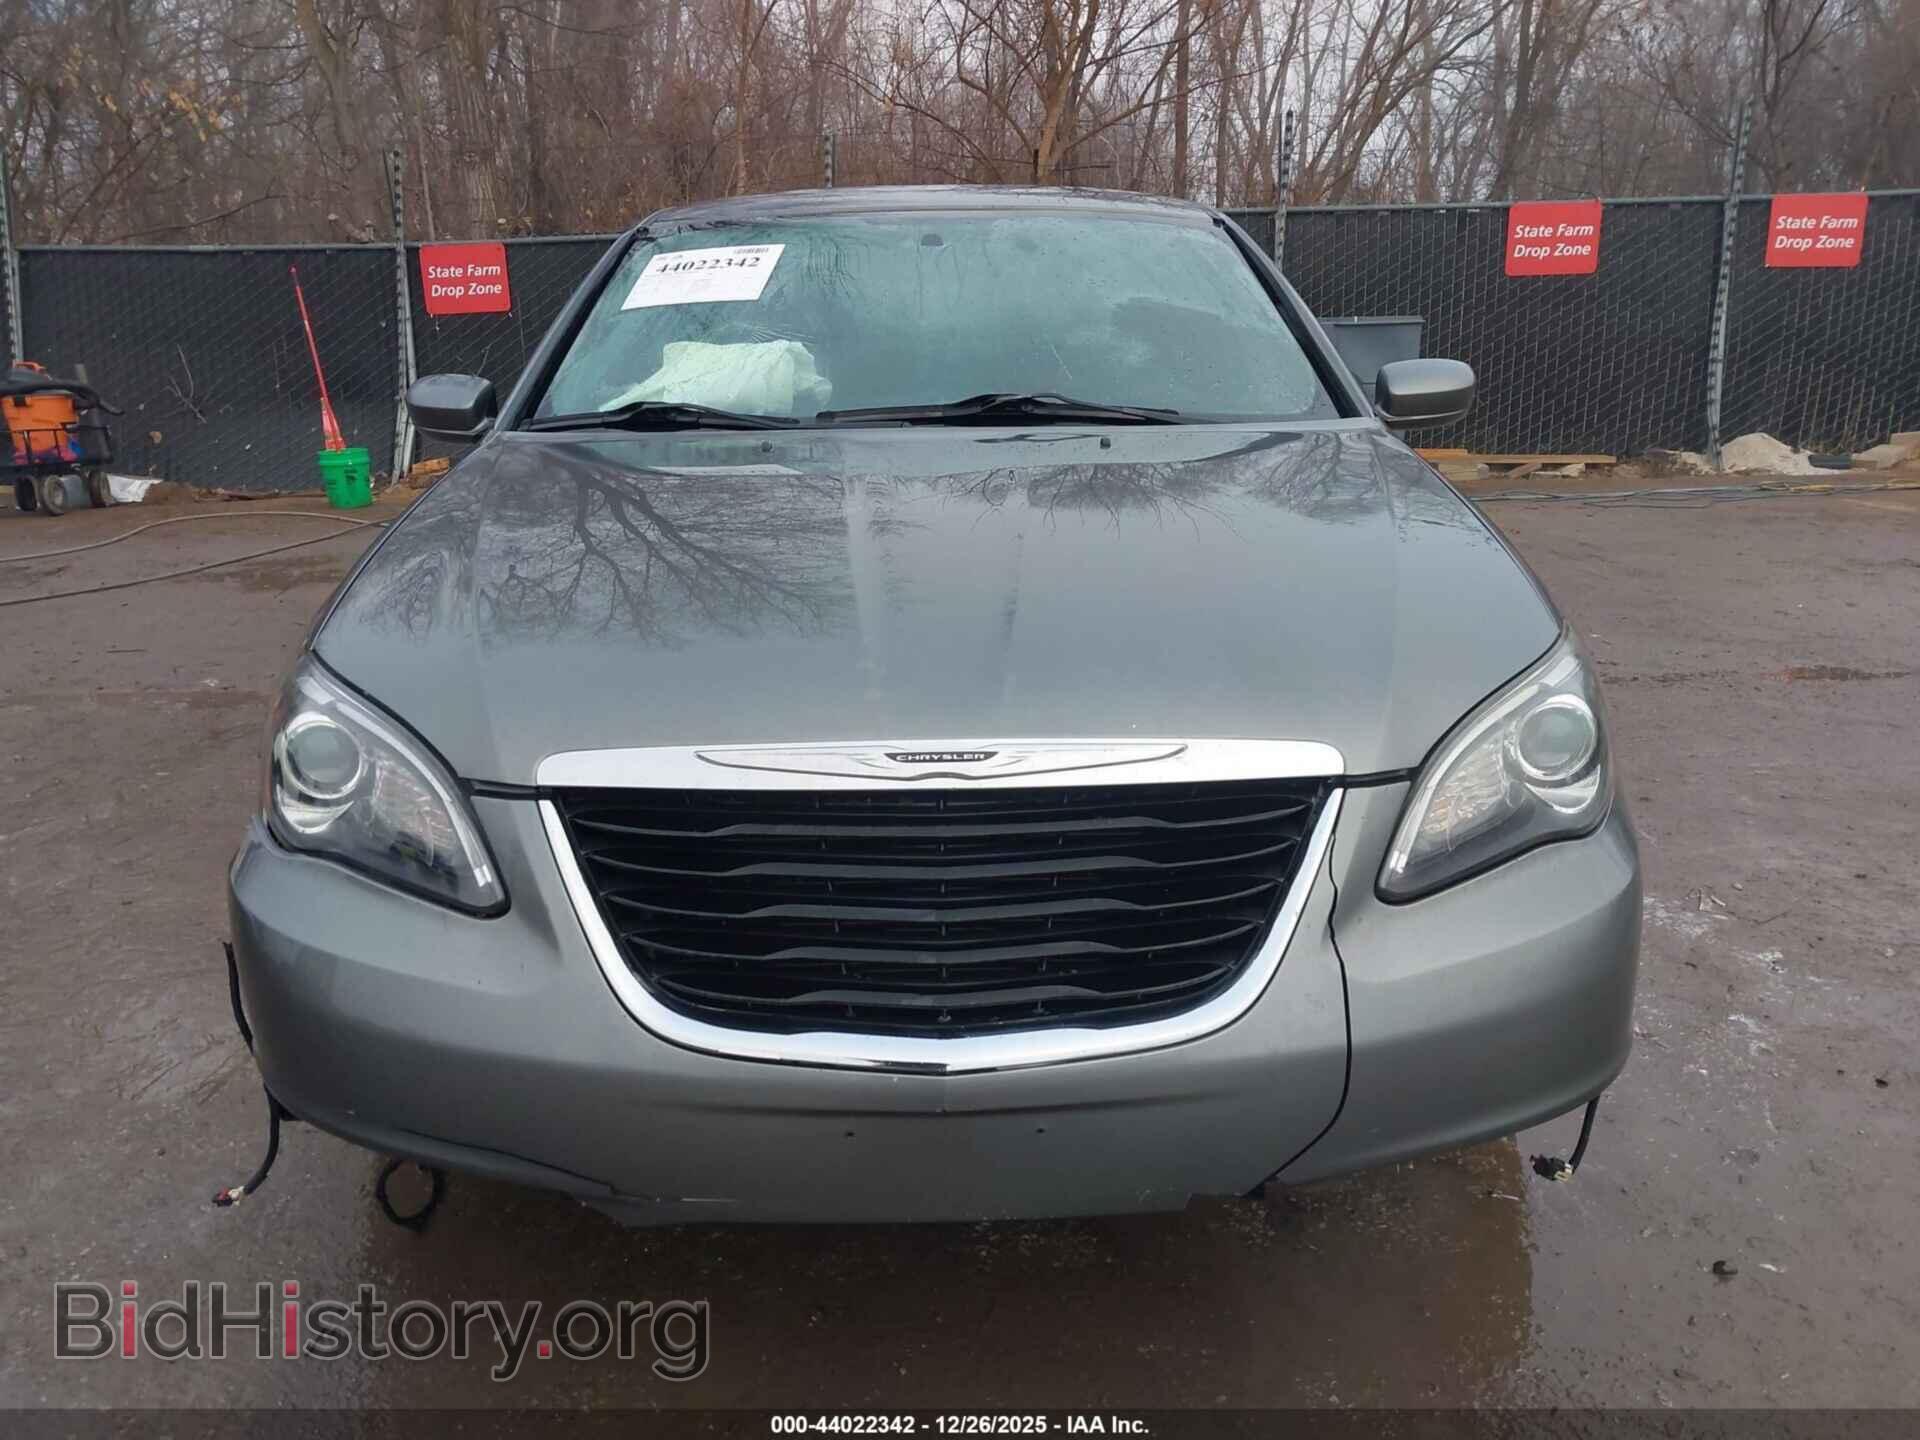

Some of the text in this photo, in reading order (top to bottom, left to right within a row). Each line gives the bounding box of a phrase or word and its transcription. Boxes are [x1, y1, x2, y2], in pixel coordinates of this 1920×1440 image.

[1776, 215, 1858, 229] State Farm
[1514, 223, 1594, 238] State Farm
[1775, 234, 1855, 252] Drop Zone
[1513, 243, 1592, 260] Drop Zone
[427, 264, 501, 279] State Farm
[655, 256, 761, 274] 44022342
[431, 282, 502, 299] Drop Zone
[896, 753, 985, 761] CHRYSLER
